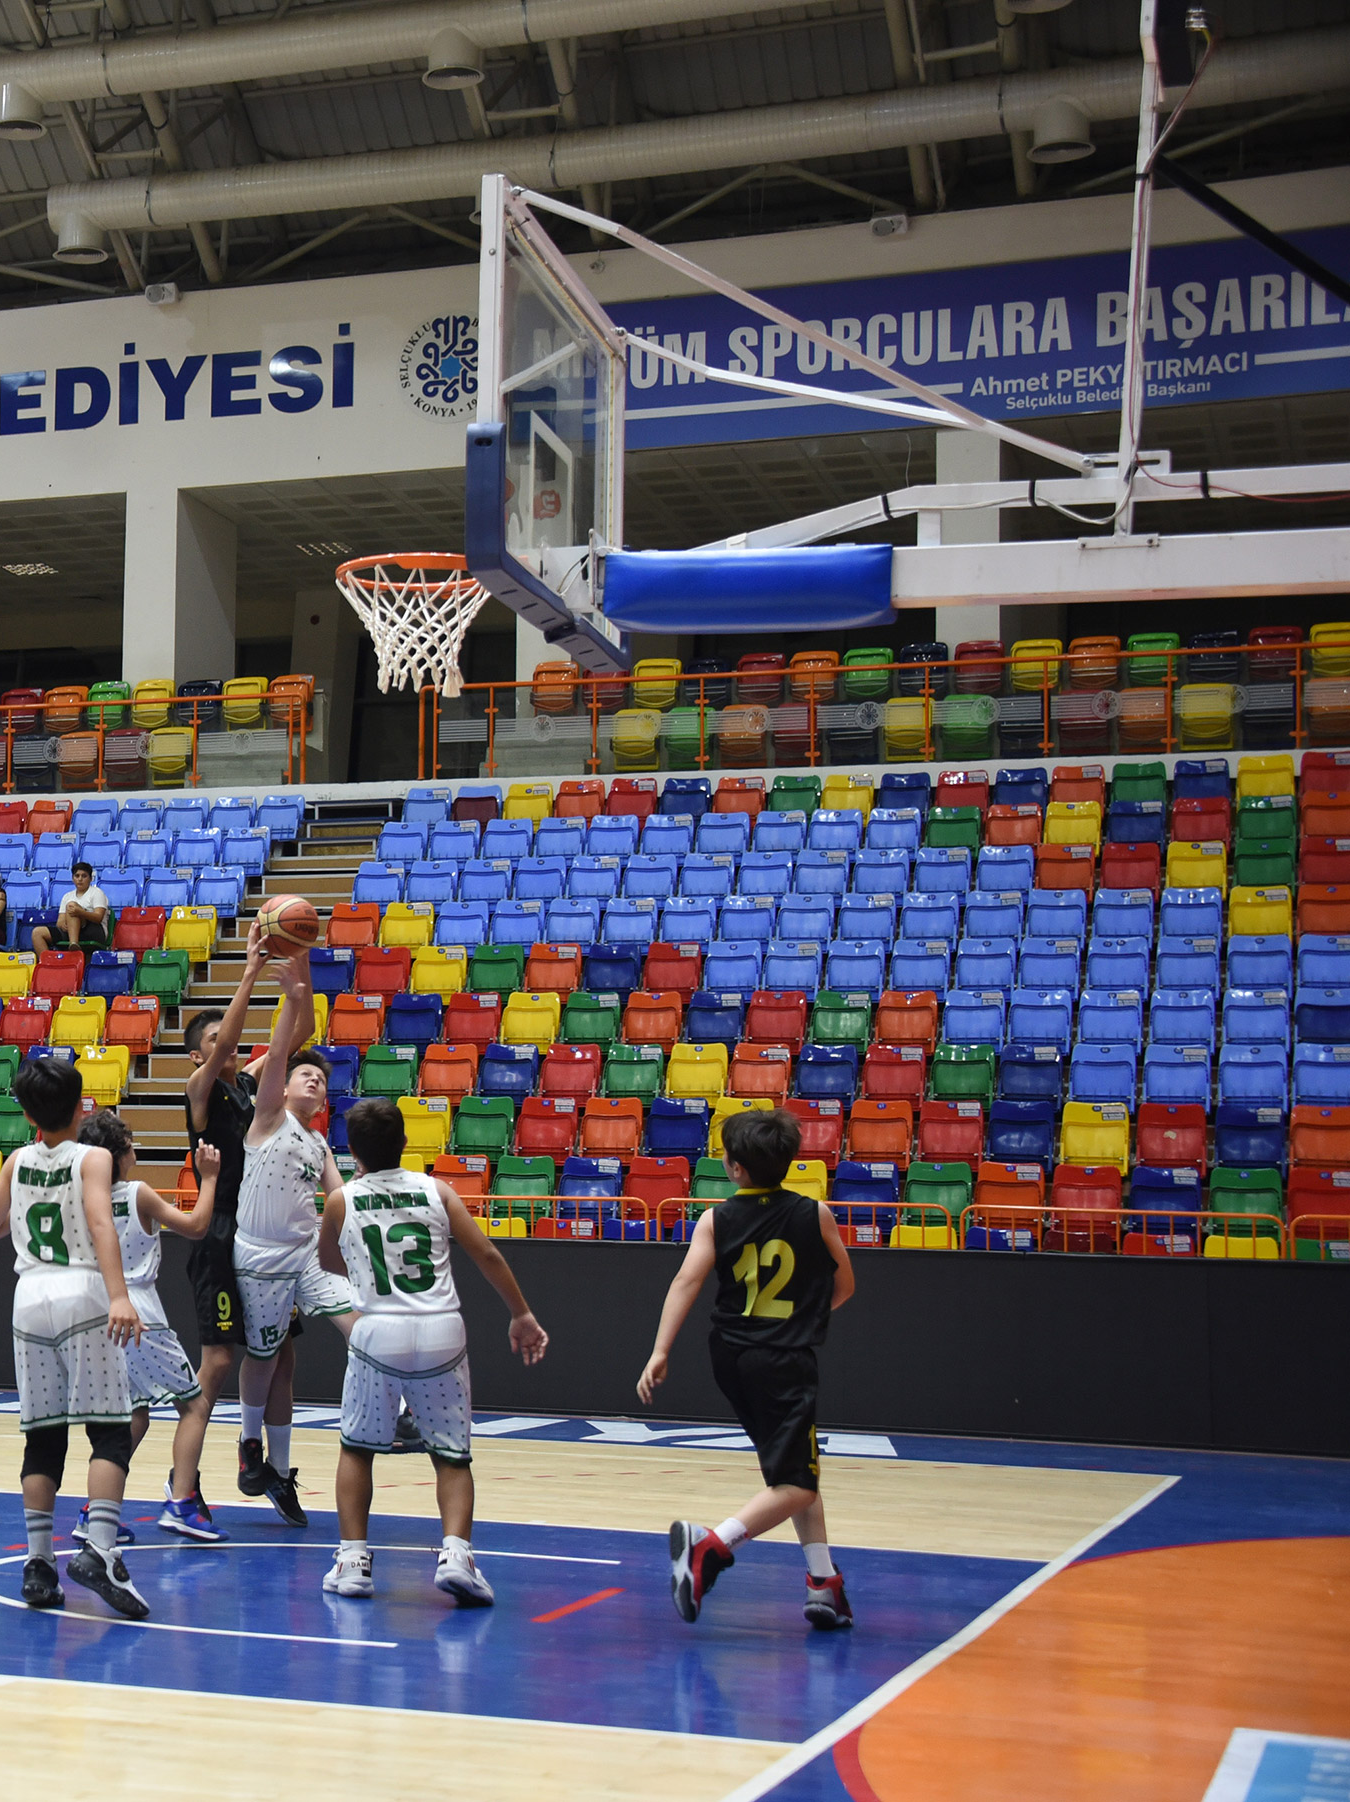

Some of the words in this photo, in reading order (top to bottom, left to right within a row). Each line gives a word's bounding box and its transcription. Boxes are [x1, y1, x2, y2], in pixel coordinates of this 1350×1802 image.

[625, 326, 707, 390] ÜM
[728, 297, 1073, 378] SPORCULARA
[1096, 271, 1350, 348] BAŞARIL
[399, 321, 431, 388] SELÇUKLU
[970, 371, 1049, 397] Ahmet
[1056, 352, 1248, 389] PEKYTIRMACI
[414, 397, 456, 417] KONYA
[1005, 391, 1072, 411] Selçuklu
[1076, 388, 1124, 403] Beledi
[1147, 381, 1211, 399] Başkanı
[26, 1202, 70, 1266] 8
[361, 1222, 437, 1296] 13
[732, 1238, 796, 1319] 12
[217, 1291, 231, 1321] 9
[259, 1324, 279, 1346] 15
[181, 1361, 193, 1383] 7
